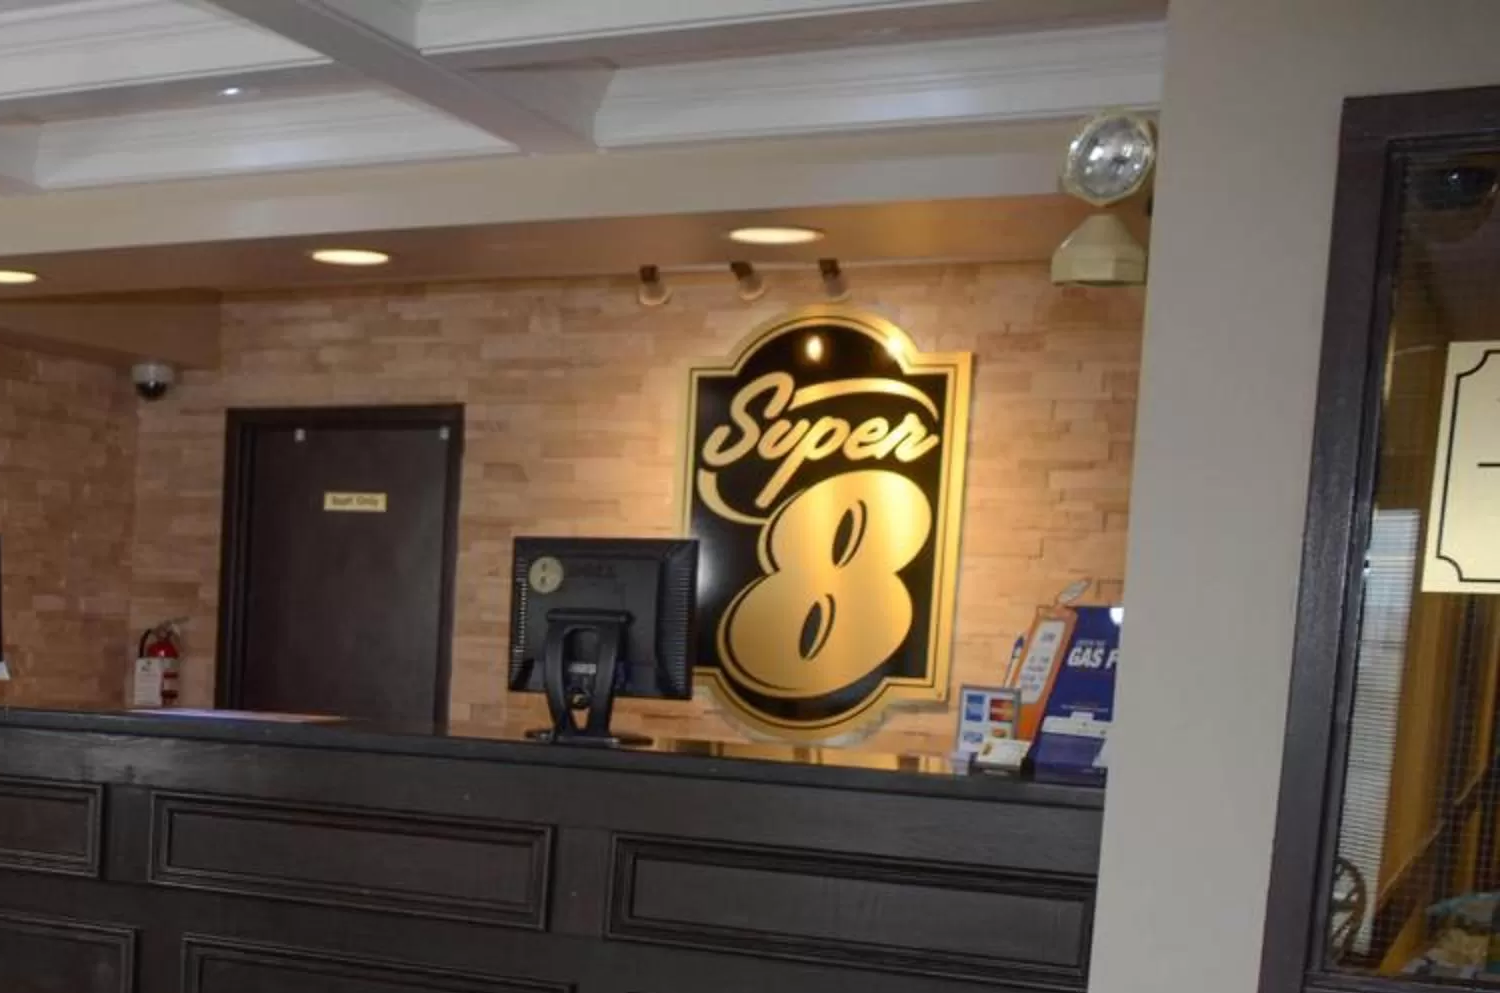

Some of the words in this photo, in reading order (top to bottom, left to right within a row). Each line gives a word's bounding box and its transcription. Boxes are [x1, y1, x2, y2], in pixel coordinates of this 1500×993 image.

[701, 371, 940, 509] Super
[717, 469, 933, 699] 8
[1067, 648, 1103, 669] GAS
